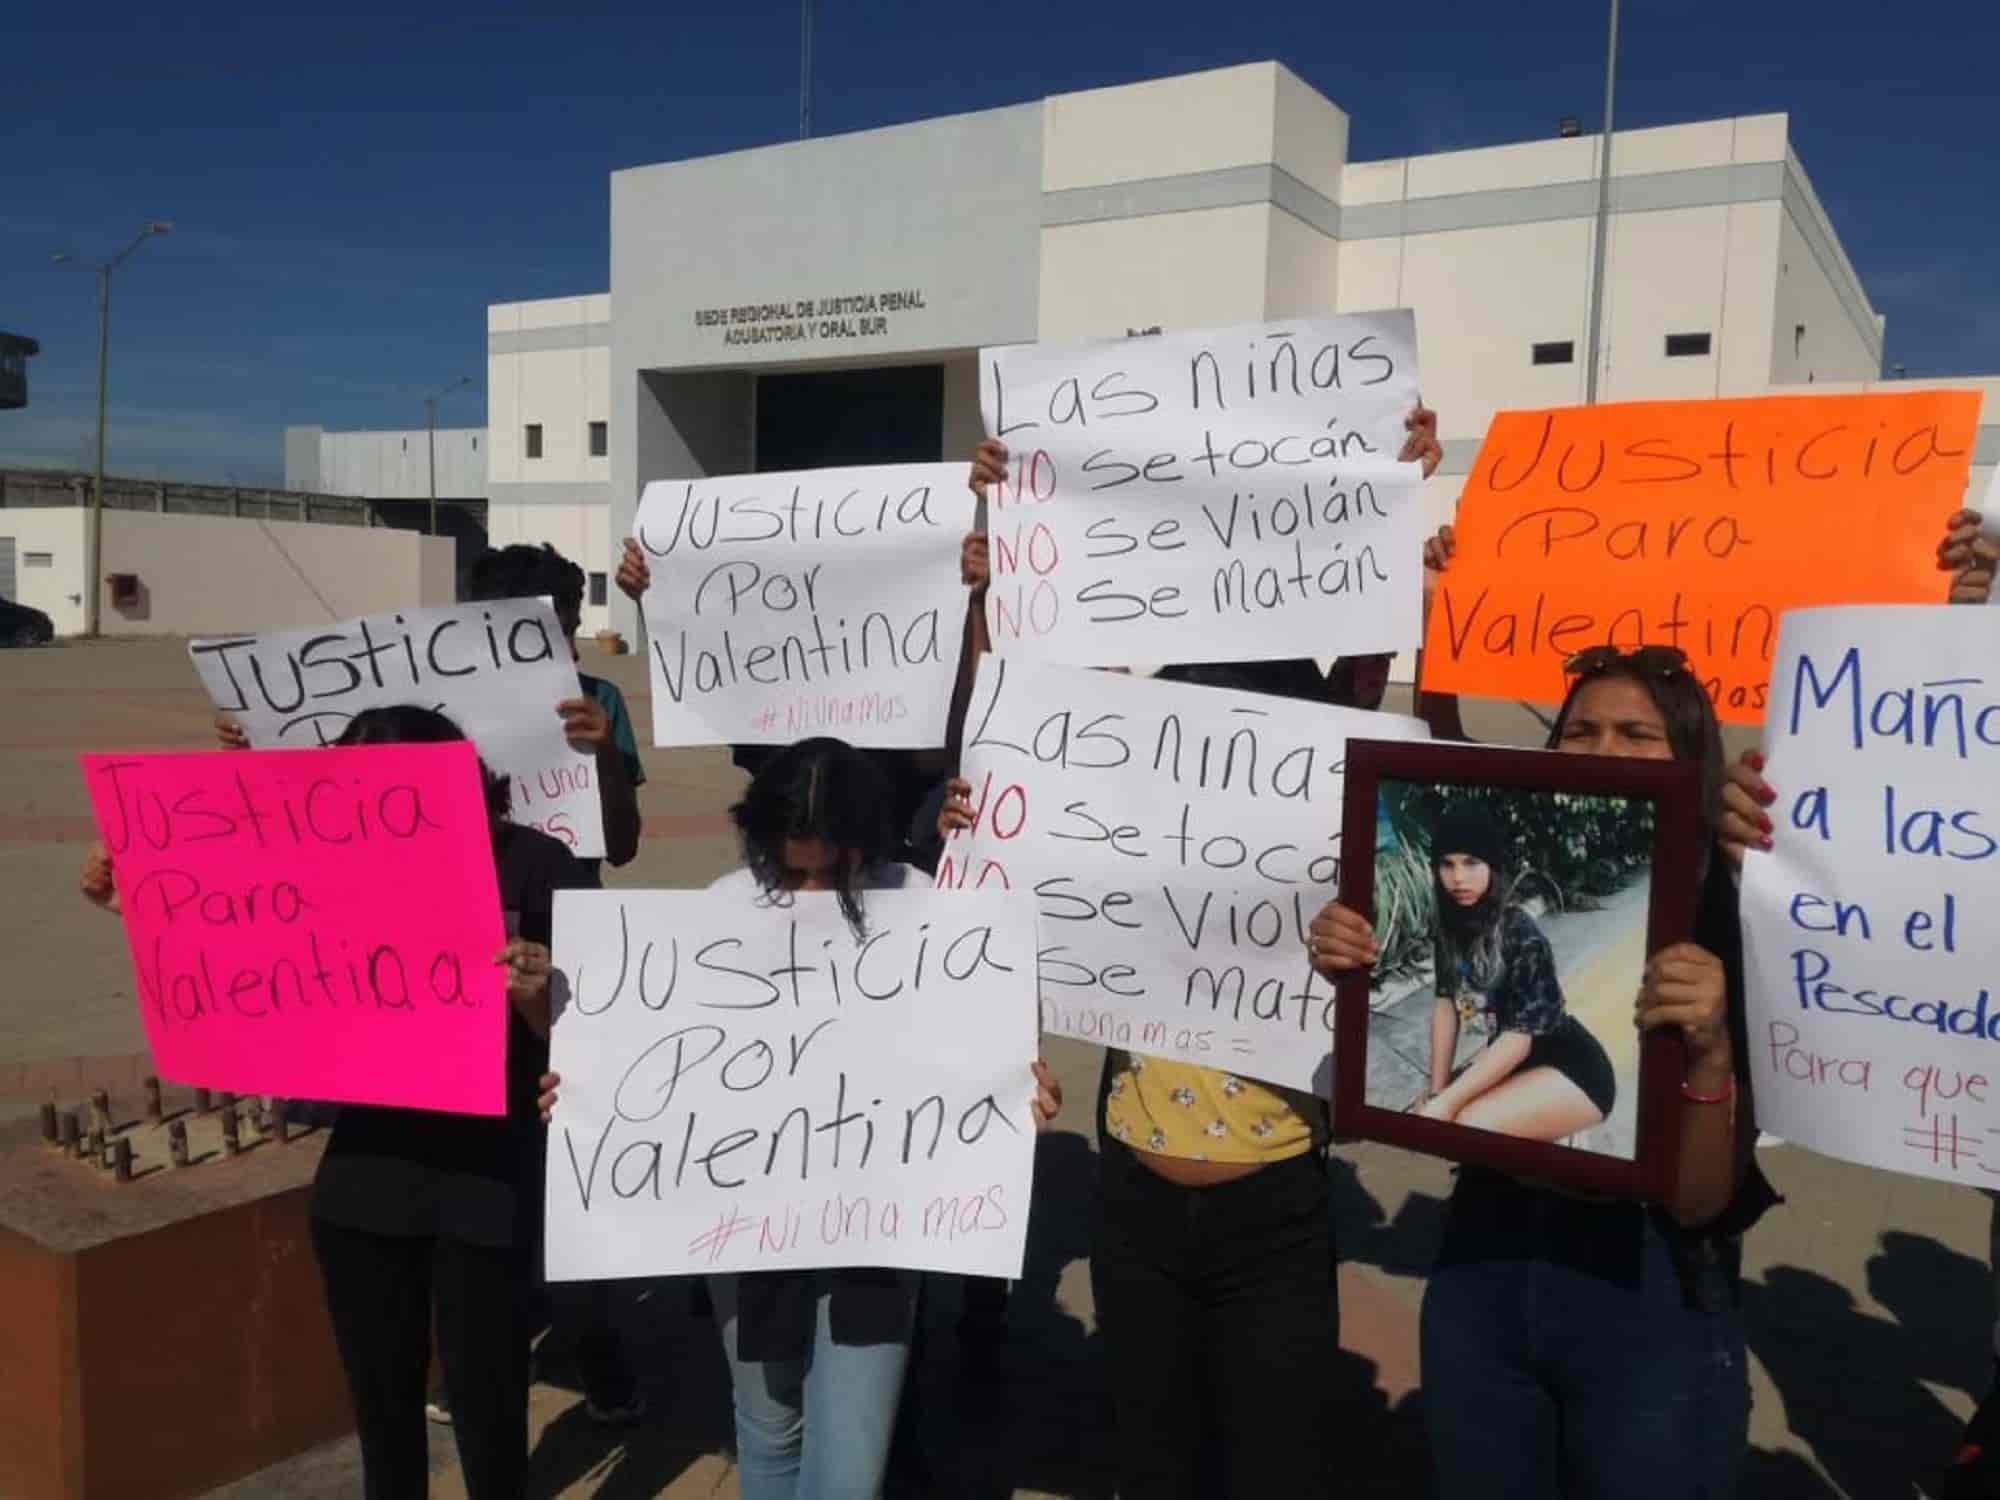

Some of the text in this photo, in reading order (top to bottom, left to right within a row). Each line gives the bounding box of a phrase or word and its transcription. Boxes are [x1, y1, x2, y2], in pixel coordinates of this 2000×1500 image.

[695, 289, 926, 326] SEDE REGIONAL DE JUSTICIA PENAL
[724, 316, 888, 346] ACUSATORIA Y ORAL SUR
[993, 333, 1395, 437] Las niñas
[996, 521, 1059, 576] NO
[1496, 506, 1754, 561] Para
[695, 560, 822, 616] Por
[996, 578, 1059, 640] NO
[1441, 586, 1775, 662] Valentin
[653, 608, 944, 703] Valentina
[969, 657, 1131, 770] Las
[1163, 802, 1341, 885] tocá
[1791, 783, 1999, 861] a las
[133, 868, 313, 926] Para
[1789, 893, 1956, 953] en el
[613, 1018, 839, 1122] Por
[1767, 1020, 1989, 1118] Para que
[563, 1072, 1022, 1212] Valentina
